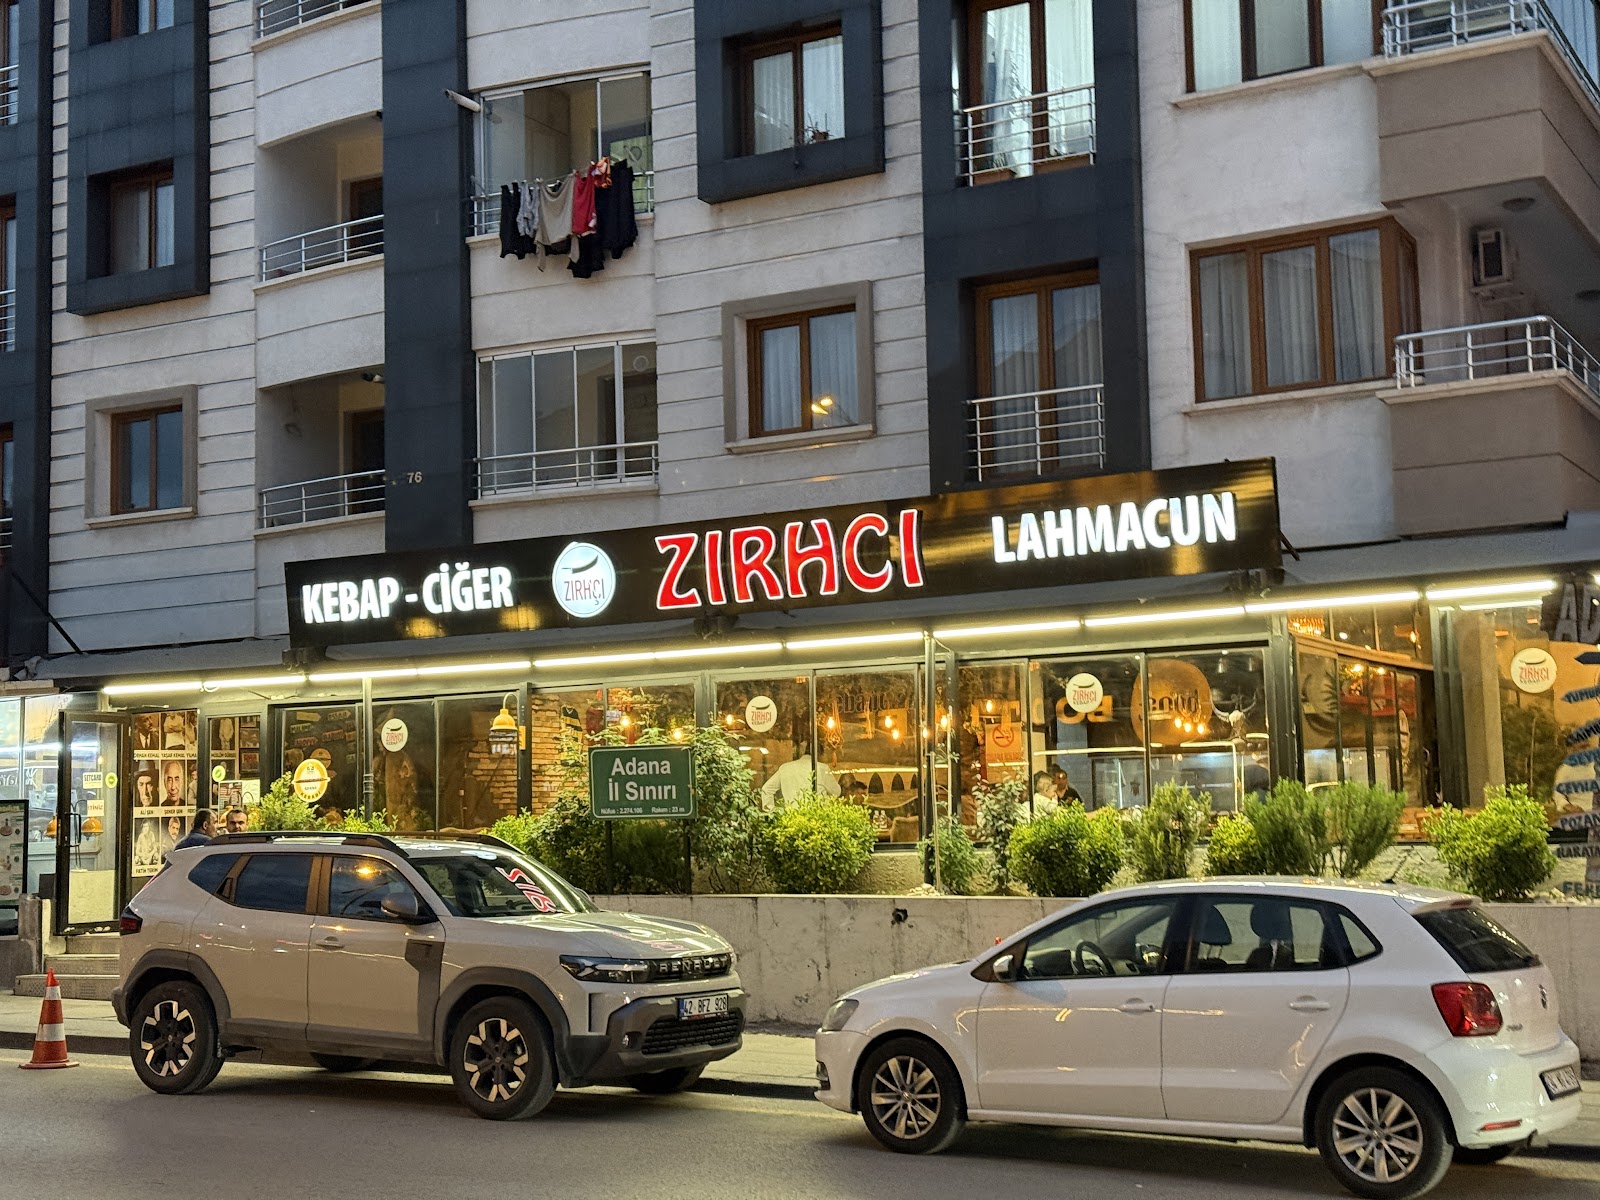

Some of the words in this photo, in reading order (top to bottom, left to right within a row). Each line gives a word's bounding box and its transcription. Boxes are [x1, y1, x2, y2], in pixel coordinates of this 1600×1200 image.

[407, 471, 422, 484] 76
[991, 491, 1237, 564] LAHMACUN
[654, 508, 924, 610] ZIRHCI
[301, 576, 400, 625] KEBAP
[421, 561, 514, 615] CİĞER
[611, 757, 671, 776] Adana
[608, 778, 619, 801] İl
[625, 781, 677, 801] Sınırı
